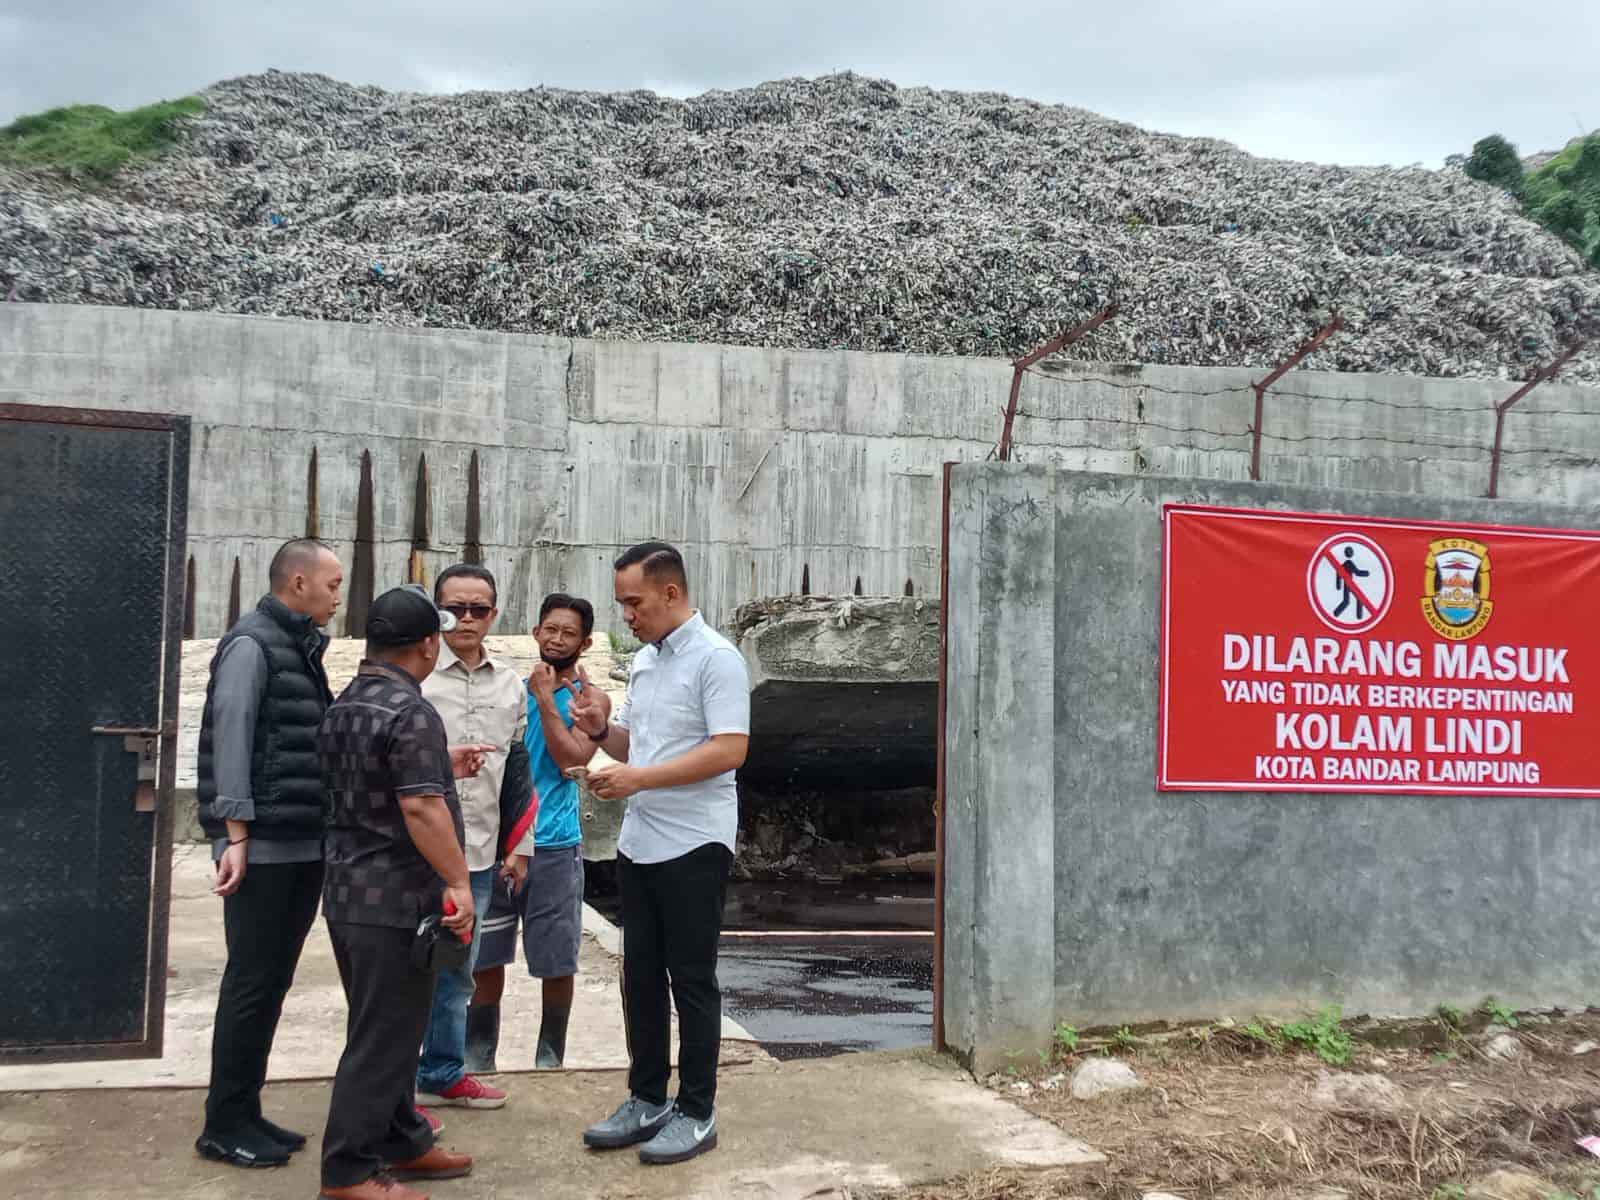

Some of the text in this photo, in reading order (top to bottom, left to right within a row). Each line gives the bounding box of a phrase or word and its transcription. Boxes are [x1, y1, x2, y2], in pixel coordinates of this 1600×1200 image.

[1223, 633, 1570, 683] DILARANG MASUK
[1221, 679, 1573, 714] YANG TIDAK BERKEPENTINGAN
[1276, 712, 1522, 755] KOLAM LINDI
[1255, 755, 1540, 784] KOTA BANDAR LAMPUNG
